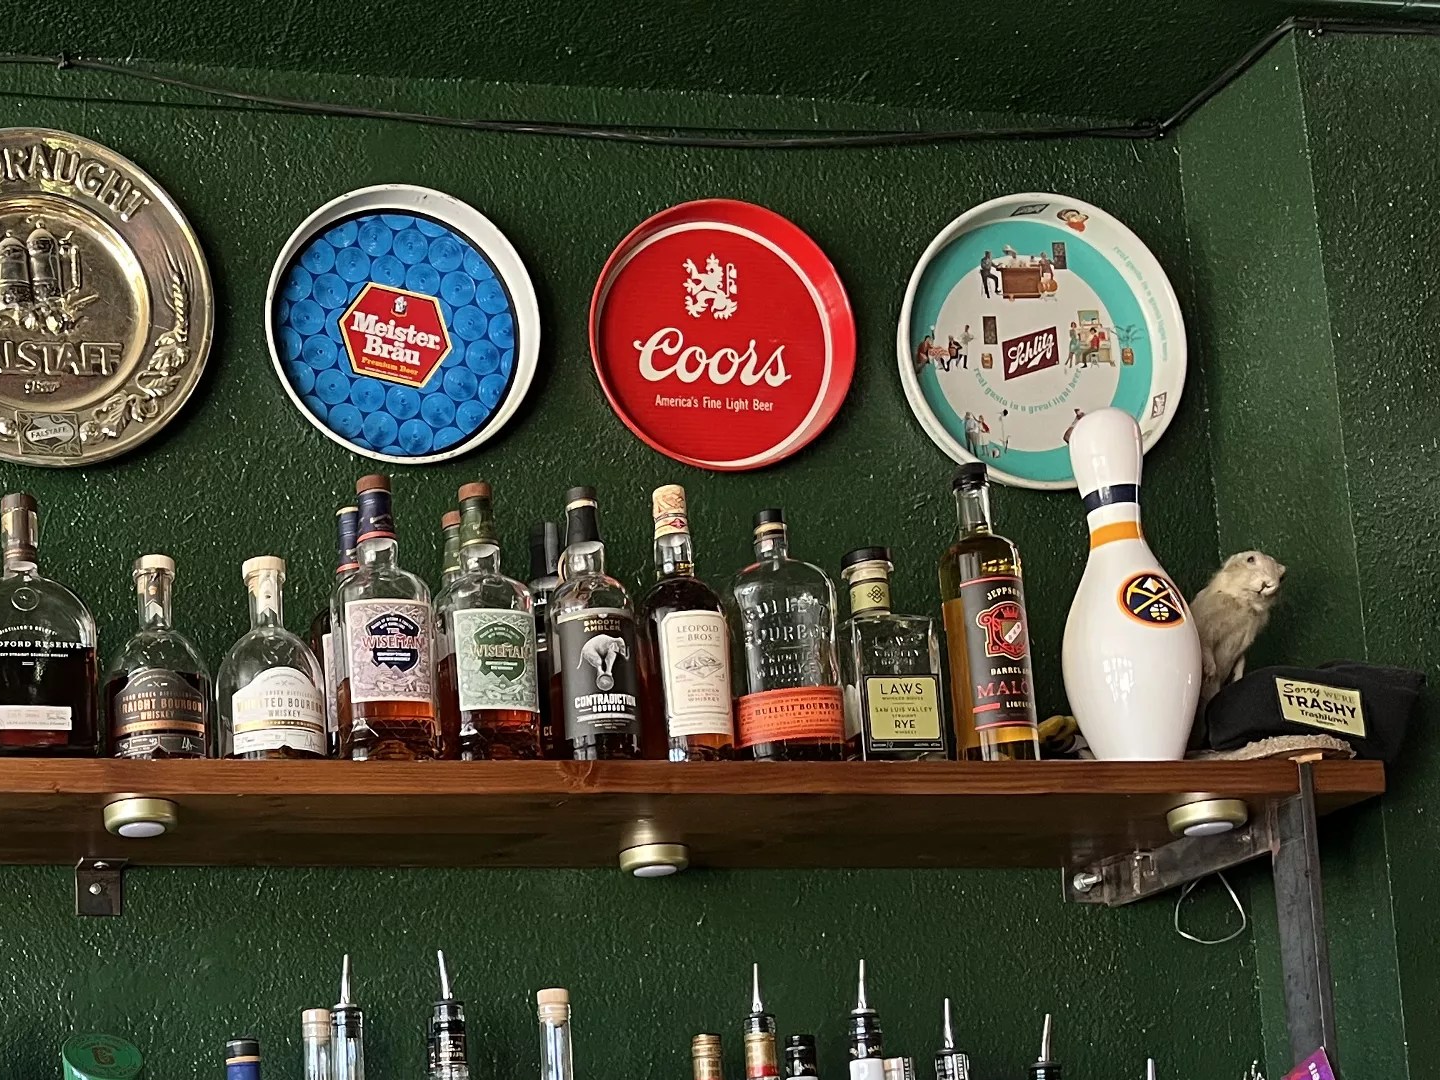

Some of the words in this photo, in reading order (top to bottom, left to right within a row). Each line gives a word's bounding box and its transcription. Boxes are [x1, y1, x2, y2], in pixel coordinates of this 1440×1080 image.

[362, 334, 421, 366] Bräu
[632, 327, 792, 387] Coors
[1008, 332, 1055, 374] Schlitz
[655, 394, 699, 408] America's
[703, 396, 722, 409] Fine
[726, 397, 749, 413] Light
[753, 399, 773, 411] Beer
[677, 625, 719, 633] LEOPOLD
[362, 634, 425, 650] WISEMAN
[688, 633, 713, 642] BROS
[34, 640, 83, 650] RESERVE
[881, 683, 923, 695] LAWS
[1283, 683, 1321, 697] Sorry
[575, 694, 636, 708] CONTRADICTION
[1283, 694, 1357, 721] TRASHY
[140, 711, 175, 721] WHISKEY
[755, 704, 797, 716] BULLEIT
[894, 719, 916, 729] RYE
